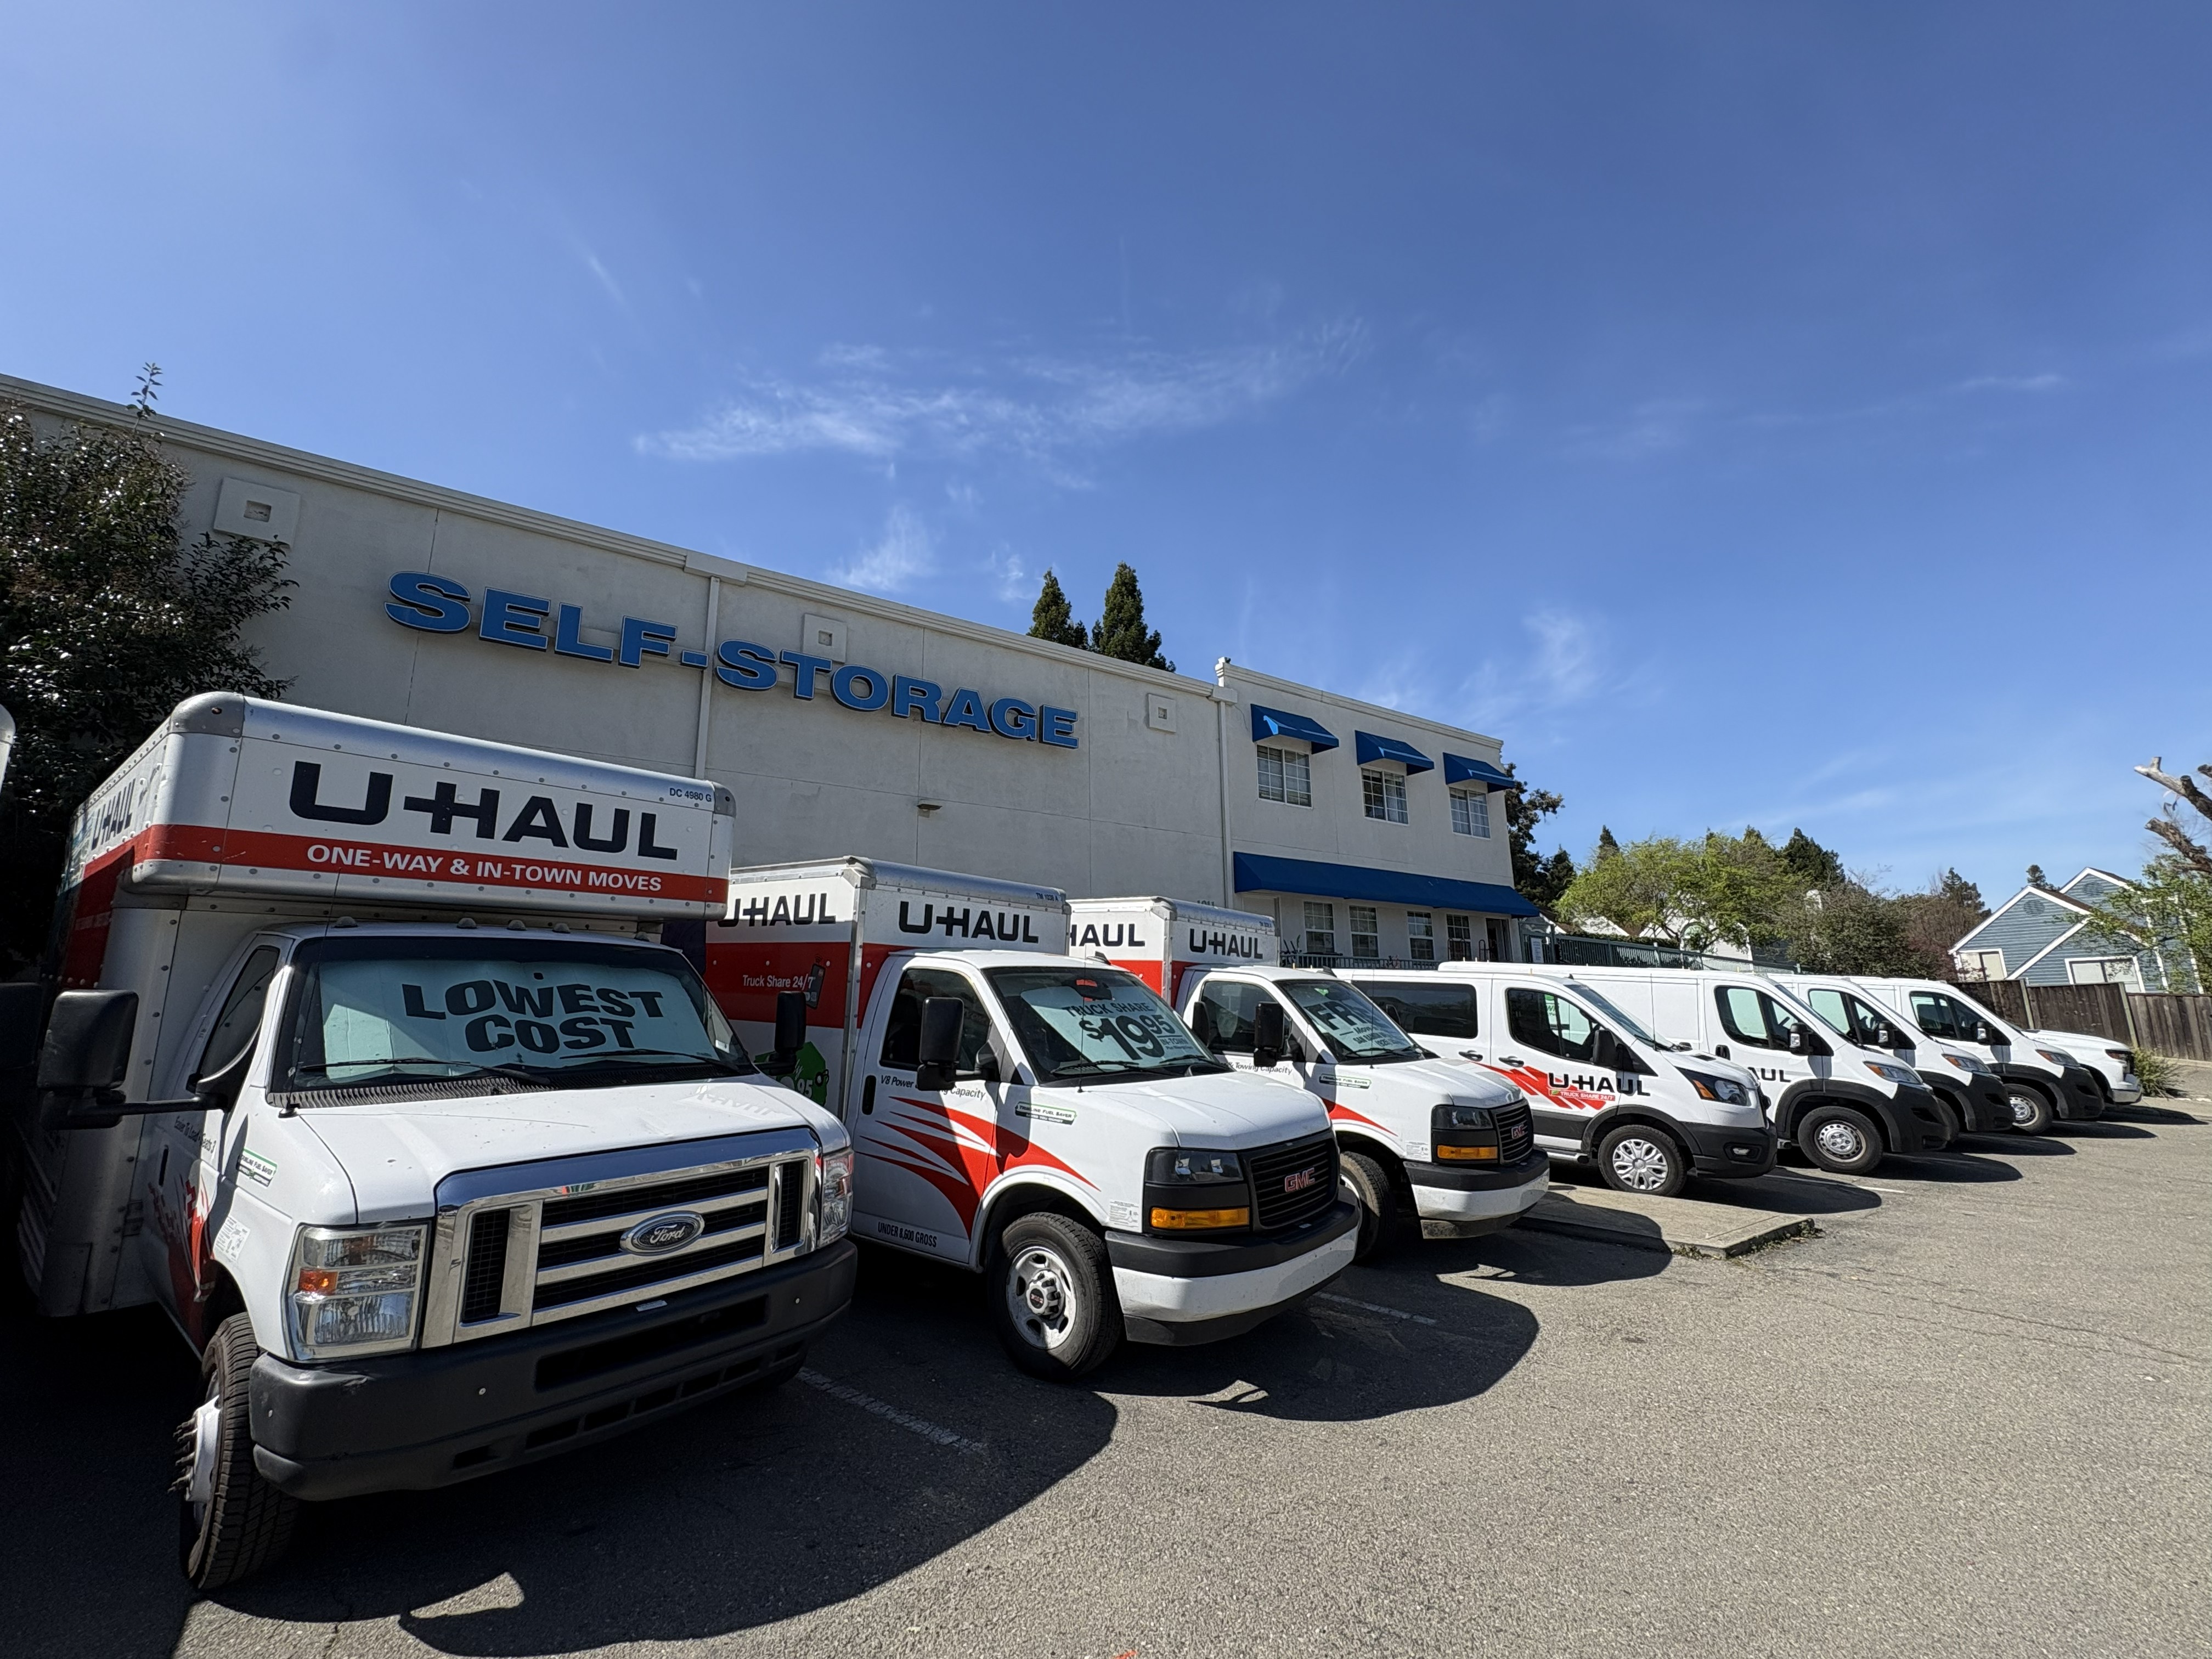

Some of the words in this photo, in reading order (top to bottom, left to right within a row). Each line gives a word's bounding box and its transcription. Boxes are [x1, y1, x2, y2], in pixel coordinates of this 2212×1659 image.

[384, 571, 1079, 749] SELF-STORAGE
[669, 787, 682, 797] DC
[684, 791, 703, 800] 4980
[706, 794, 712, 802] G
[289, 760, 678, 860] U-HAUL
[307, 844, 444, 873] ONE-WAY
[450, 859, 470, 876] &
[476, 861, 582, 885] IN-TOWN
[588, 871, 662, 891] MOVES
[899, 901, 1039, 944] U-HAUL
[1189, 928, 1263, 959] U-HAUL
[743, 975, 765, 987] Truck
[766, 975, 791, 988] Share
[402, 979, 664, 1019] LOWEST
[1062, 1003, 1113, 1017] TRUCK
[1110, 1002, 1154, 1013] SHARE
[465, 1014, 635, 1054] COST
[881, 1075, 890, 1085] V8
[891, 1076, 915, 1088] Power
[1548, 1073, 1651, 1096] U-HAUL
[1285, 1167, 1315, 1192] GMC
[650, 1223, 686, 1244] Ford
[878, 1222, 899, 1237] UNDER
[915, 1231, 937, 1248] GROSS
